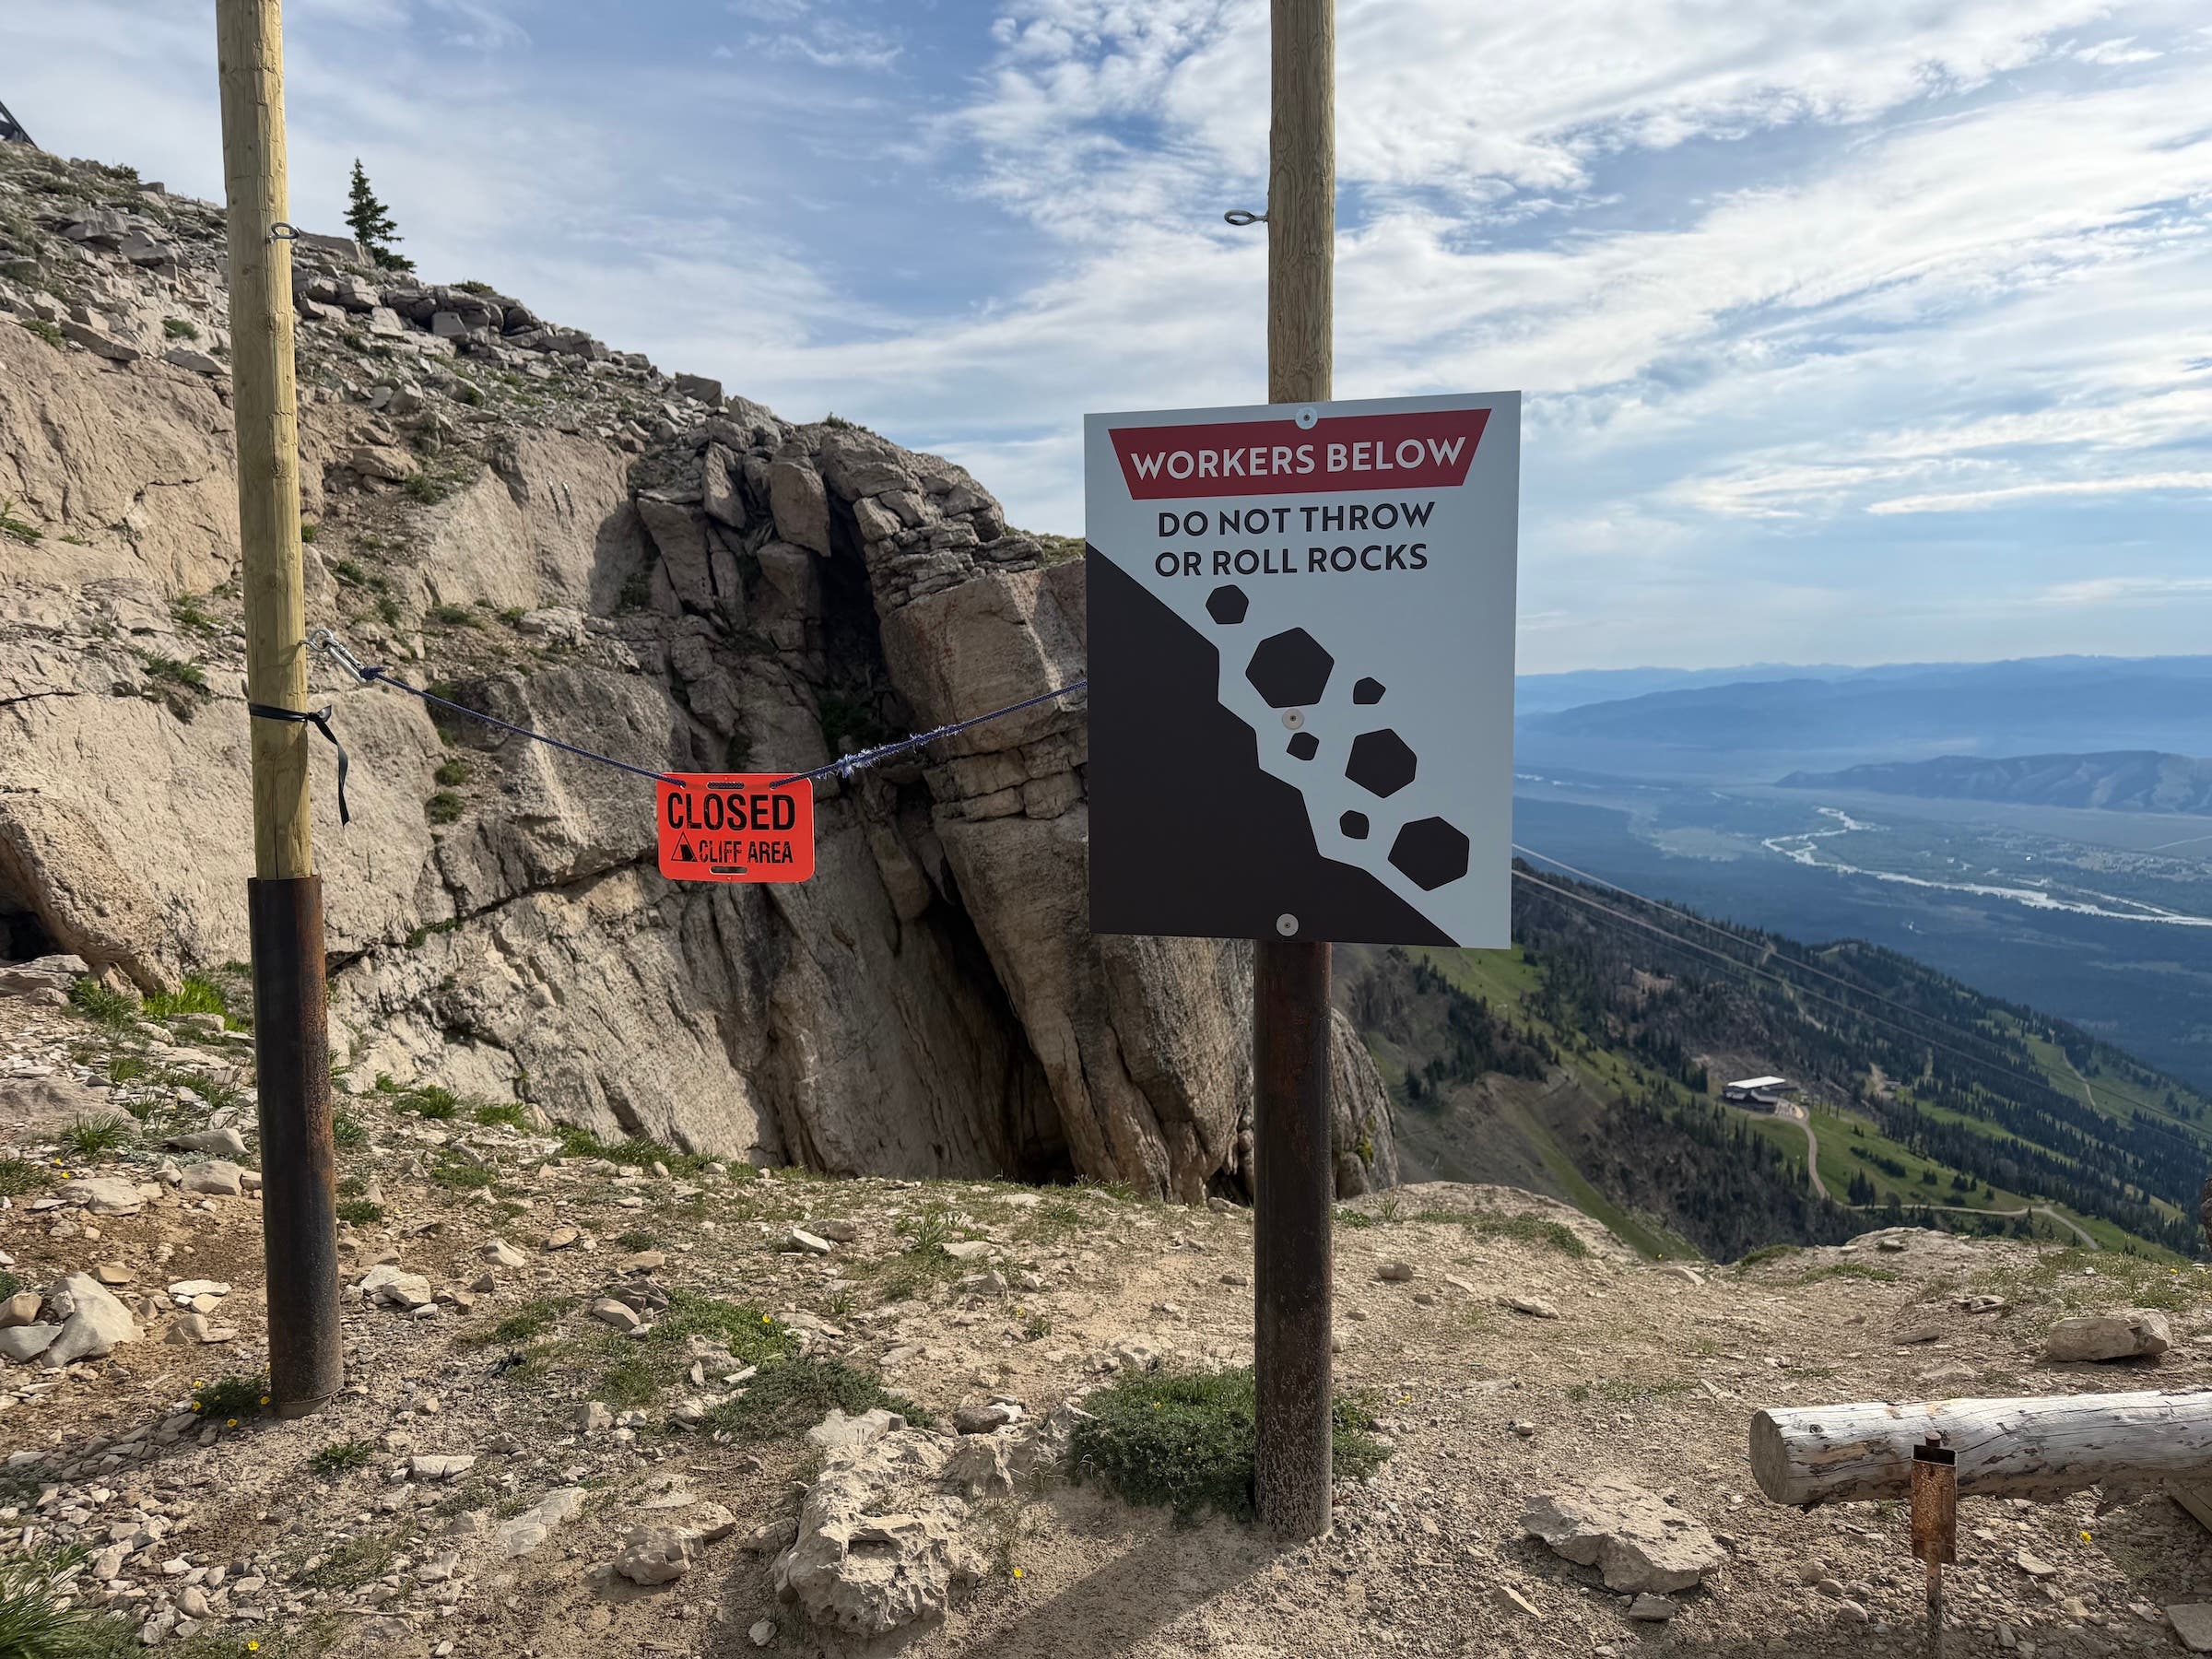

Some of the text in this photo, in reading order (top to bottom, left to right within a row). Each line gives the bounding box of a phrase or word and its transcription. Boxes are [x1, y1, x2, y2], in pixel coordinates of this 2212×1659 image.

[1131, 436, 1467, 479] WORKERS BELOW
[1159, 501, 1435, 536] DO NOT THROW
[1156, 544, 1427, 577] OR ROLL ROCKS
[668, 793, 794, 830] CLOSED
[700, 840, 793, 863] CLIFF AREA
